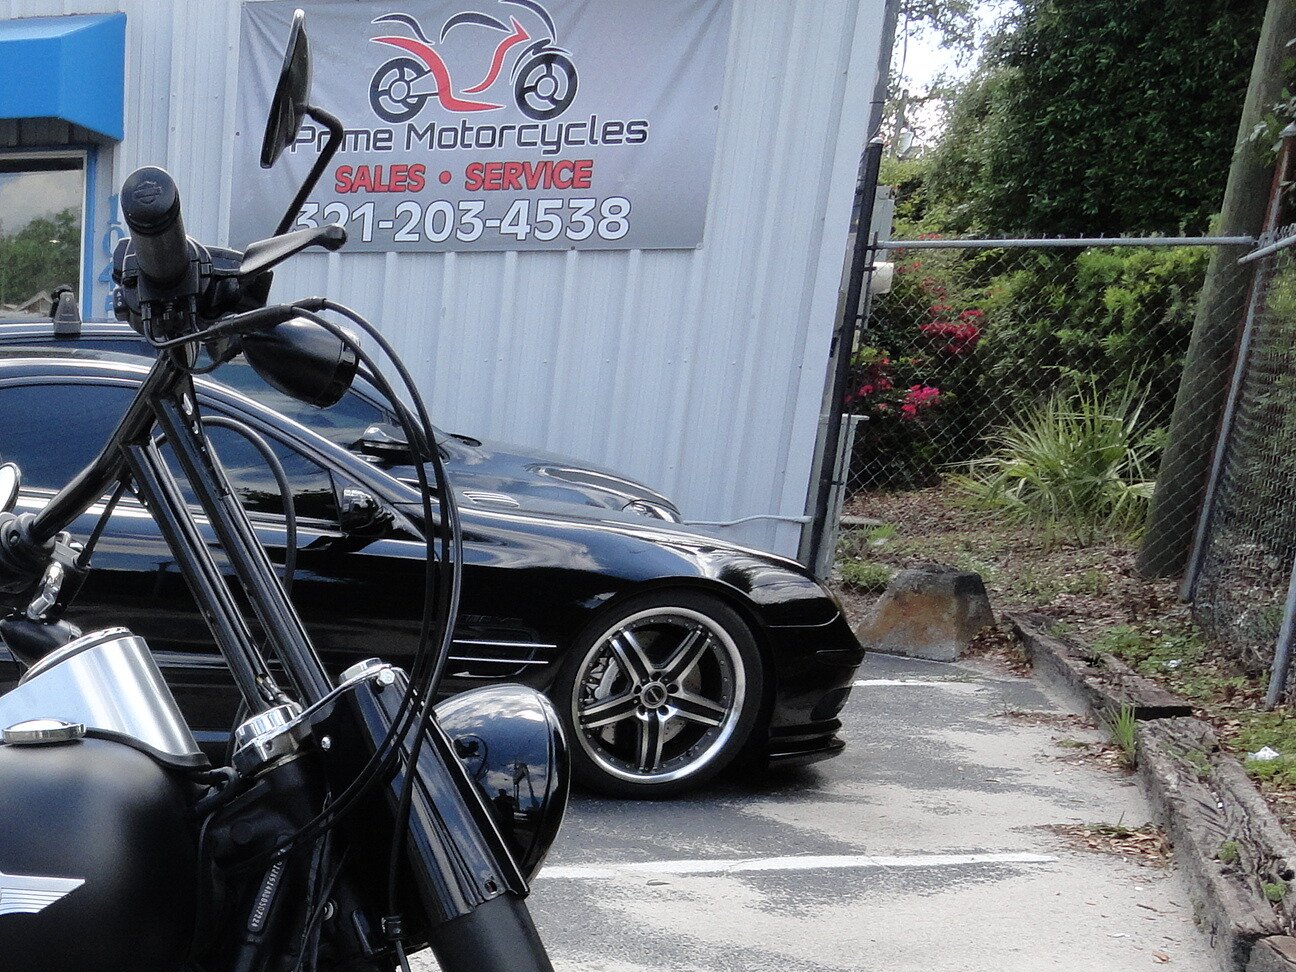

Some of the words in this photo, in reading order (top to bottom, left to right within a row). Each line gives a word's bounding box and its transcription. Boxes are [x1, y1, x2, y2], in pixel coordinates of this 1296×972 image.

[290, 124, 394, 153] Prme
[406, 114, 649, 156] Motorcycles
[335, 164, 426, 194] SALES
[464, 159, 593, 192] SERVICE
